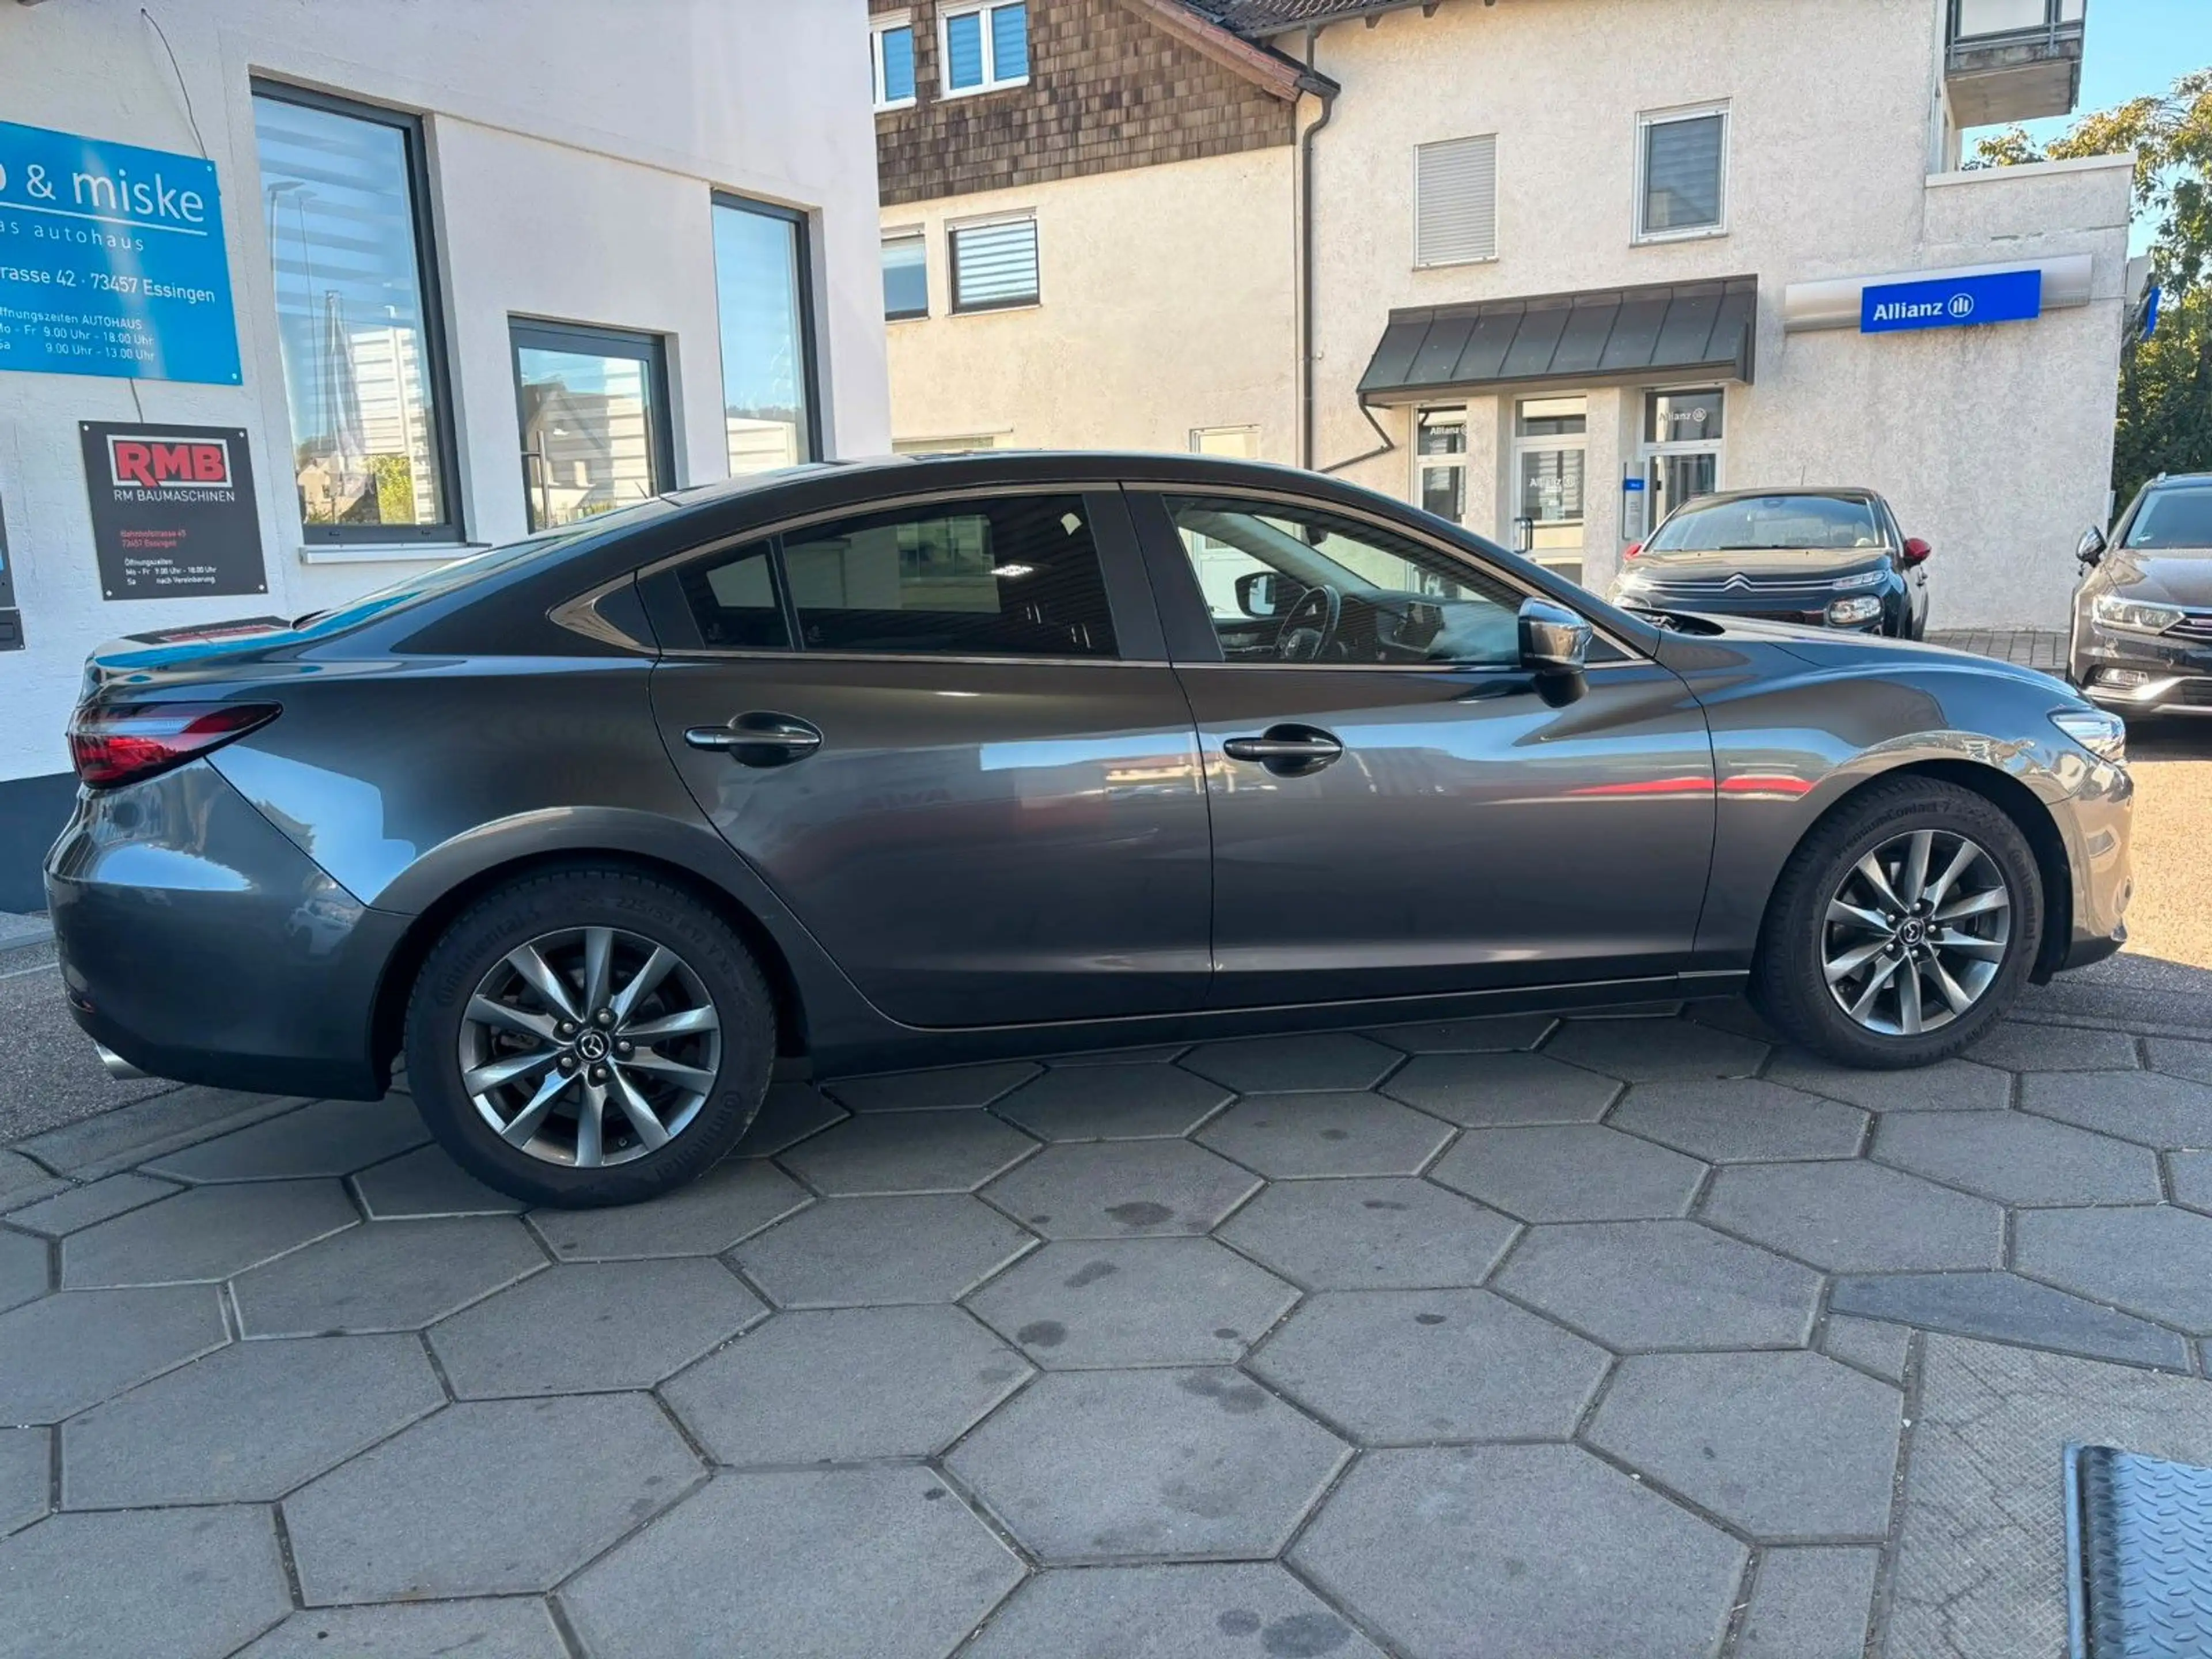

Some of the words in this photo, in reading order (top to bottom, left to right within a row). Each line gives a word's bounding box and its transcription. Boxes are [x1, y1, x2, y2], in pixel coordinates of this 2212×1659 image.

[27, 164, 56, 200] &
[72, 169, 204, 222] miske
[34, 225, 143, 251] autohaus
[56, 269, 77, 287] 42
[90, 272, 138, 293] 73457
[143, 279, 215, 304] Essingen
[1873, 301, 1944, 321] Allianz
[82, 315, 142, 330] AUTOHAUS
[24, 325, 36, 335] Fr
[44, 326, 67, 339] 9.00
[70, 329, 90, 340] Uhr
[104, 331, 131, 344] 18.00
[134, 334, 154, 346] Uhr
[72, 344, 92, 355] Uhr
[135, 348, 154, 362] Uhr
[115, 442, 225, 487] RMB
[114, 490, 133, 501] RM
[137, 490, 235, 502] BAUMASCHINEN
